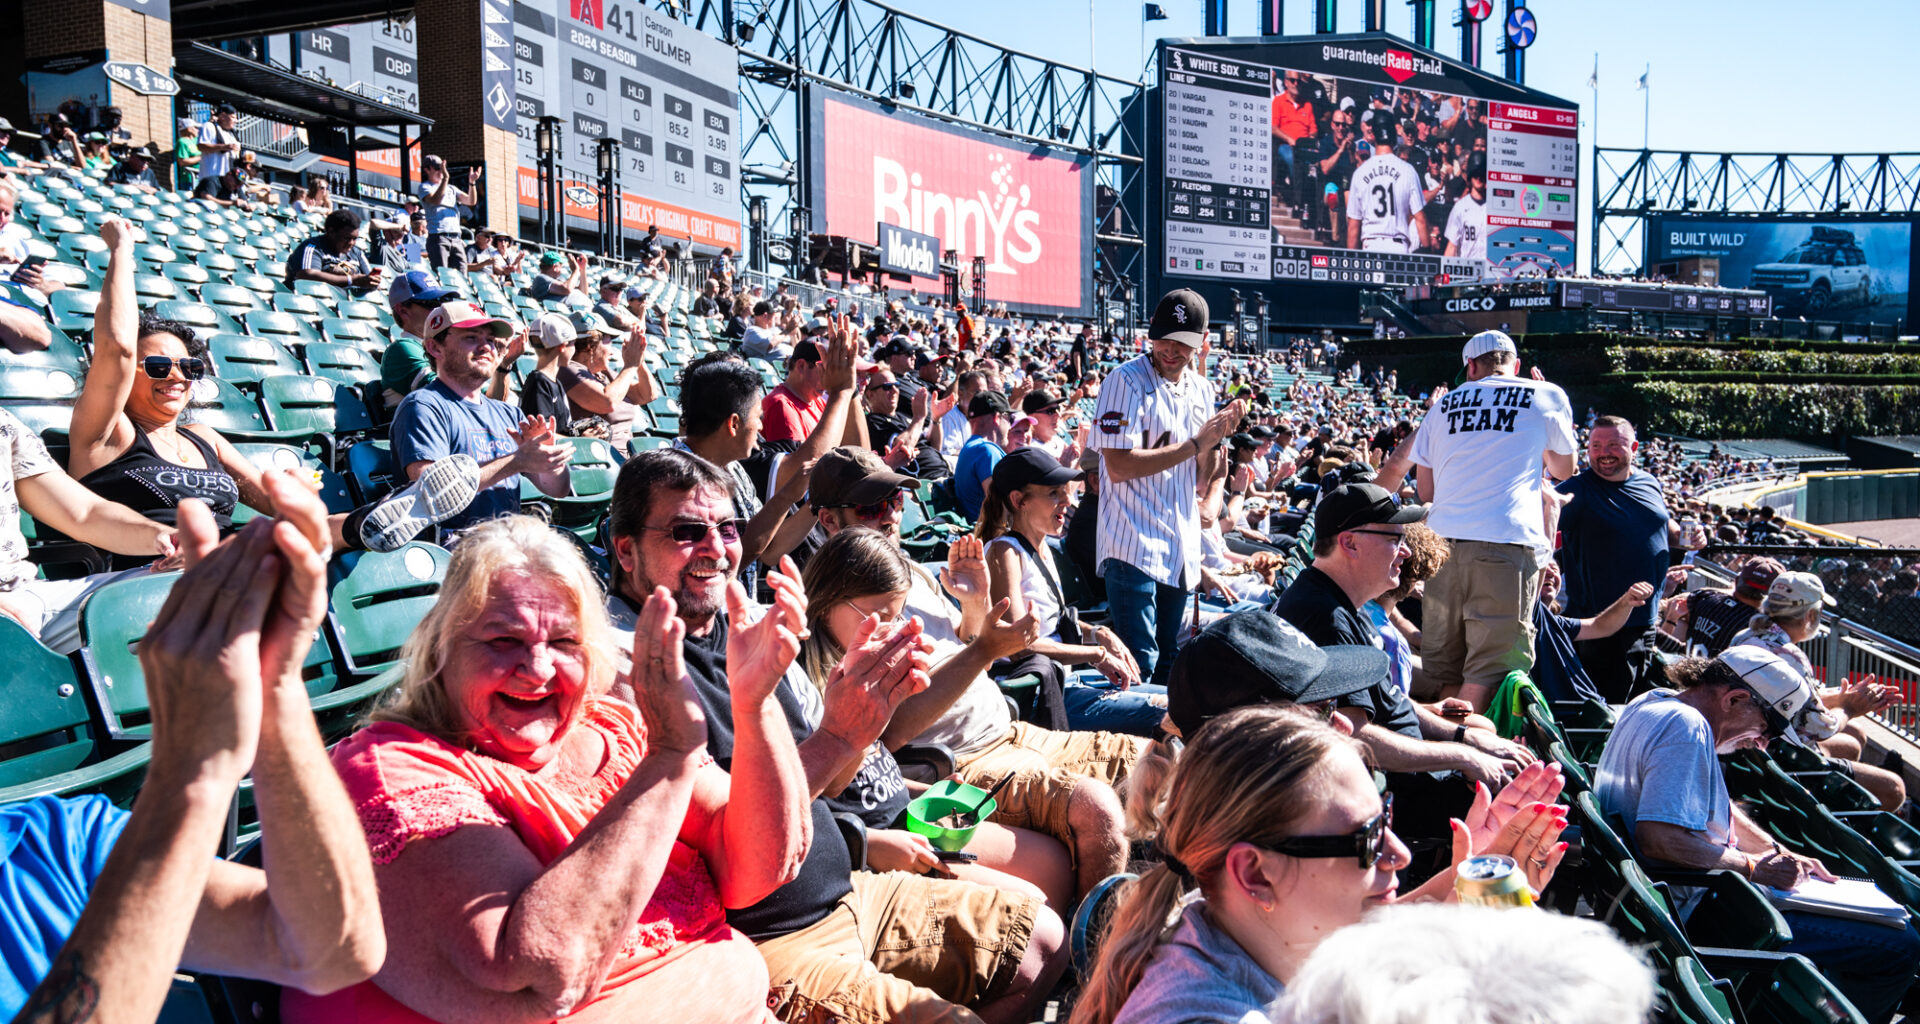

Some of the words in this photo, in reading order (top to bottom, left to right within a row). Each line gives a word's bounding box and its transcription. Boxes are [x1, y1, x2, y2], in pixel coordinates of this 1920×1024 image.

[607, 3, 637, 42] 41
[645, 16, 673, 38] Carson
[312, 32, 332, 53] HR
[570, 29, 597, 52] 2024
[599, 41, 637, 68] SEASON
[515, 42, 532, 60] RBI
[645, 34, 691, 66] FULMER
[385, 56, 412, 76] OBP
[1189, 57, 1218, 73] WHITE
[1220, 63, 1240, 77] SOX
[1322, 45, 1386, 67] guaranteed
[1387, 53, 1412, 70] Rate
[1412, 57, 1443, 76] Field
[110, 65, 131, 81] 158
[152, 77, 174, 92] 159
[516, 68, 533, 85] 15
[583, 67, 596, 82] SV
[1169, 72, 1185, 83] LINE
[1186, 74, 1197, 84] UP
[586, 92, 594, 106] 0
[628, 84, 645, 100] HLD
[1168, 89, 1177, 98] 20
[1182, 92, 1207, 103] VARGAS
[516, 99, 536, 116] OPS
[674, 102, 682, 113] IP
[1182, 105, 1205, 116] ROBERT
[1206, 108, 1215, 117] JR.
[1507, 107, 1538, 121] ANGELS
[633, 109, 640, 122] 0
[709, 115, 724, 130] ERA
[1168, 115, 1177, 124] 25
[1182, 118, 1208, 128] VAUGHN
[578, 119, 603, 136] WHIP
[669, 121, 689, 139] 85.2
[1168, 129, 1178, 137] 50
[1182, 131, 1199, 139] SOSA
[633, 136, 641, 149] H
[708, 135, 727, 152] 3.99
[1168, 141, 1177, 149] 44
[1182, 143, 1204, 153] RAMOS
[676, 150, 683, 162] K
[1502, 148, 1517, 156] WARD
[631, 158, 645, 173] 79
[1168, 154, 1177, 162] 31
[1182, 156, 1210, 166] DELOACH
[712, 161, 723, 174] BB
[1168, 167, 1177, 175] 47
[1182, 169, 1213, 179] ROBINSON
[674, 171, 686, 185] 81
[1500, 173, 1523, 182] FULMER
[712, 182, 724, 195] 39
[1172, 180, 1178, 188] 7
[1181, 181, 1212, 192] FLETCHER
[1243, 189, 1254, 197] 1-2
[1174, 193, 1188, 202] AVG
[1371, 182, 1395, 218] 31
[1172, 204, 1190, 215] .205
[1197, 207, 1215, 218] .254
[1227, 211, 1234, 219] 1
[1250, 213, 1261, 222] 15
[655, 207, 690, 234] ORIGINAL
[690, 216, 713, 239] CRAFT
[713, 222, 739, 245] VODKA
[1520, 218, 1552, 228] ALIGNMENT
[1182, 226, 1204, 235] AMAYA
[1670, 231, 1707, 246] BUILT
[1709, 232, 1745, 247] WILD
[888, 229, 934, 275] Modelo
[1168, 246, 1177, 254] 77
[1181, 247, 1204, 256] FLEXEN
[1288, 249, 1294, 258] S
[1250, 265, 1258, 273] 74
[1275, 262, 1295, 275] 0-0
[1300, 263, 1307, 276] 2
[1313, 257, 1326, 265] LAA
[1331, 258, 1337, 267] 0
[1342, 258, 1349, 268] 0
[1353, 259, 1360, 268] 0
[1364, 260, 1371, 269] 0
[1375, 261, 1382, 270] 0
[1314, 270, 1326, 278] SOX
[1331, 271, 1337, 280] 0
[1342, 271, 1349, 280] 0
[1353, 272, 1360, 281] 0
[1364, 273, 1371, 282] 0
[1445, 298, 1480, 312] CIBC
[1509, 298, 1527, 307] FAN
[1527, 296, 1551, 307] DECK
[1440, 388, 1483, 414] SELL
[1492, 386, 1536, 409] THE
[1447, 408, 1519, 435] TEAM
[1694, 615, 1721, 640] BUZZ
[855, 765, 880, 788] WHO
